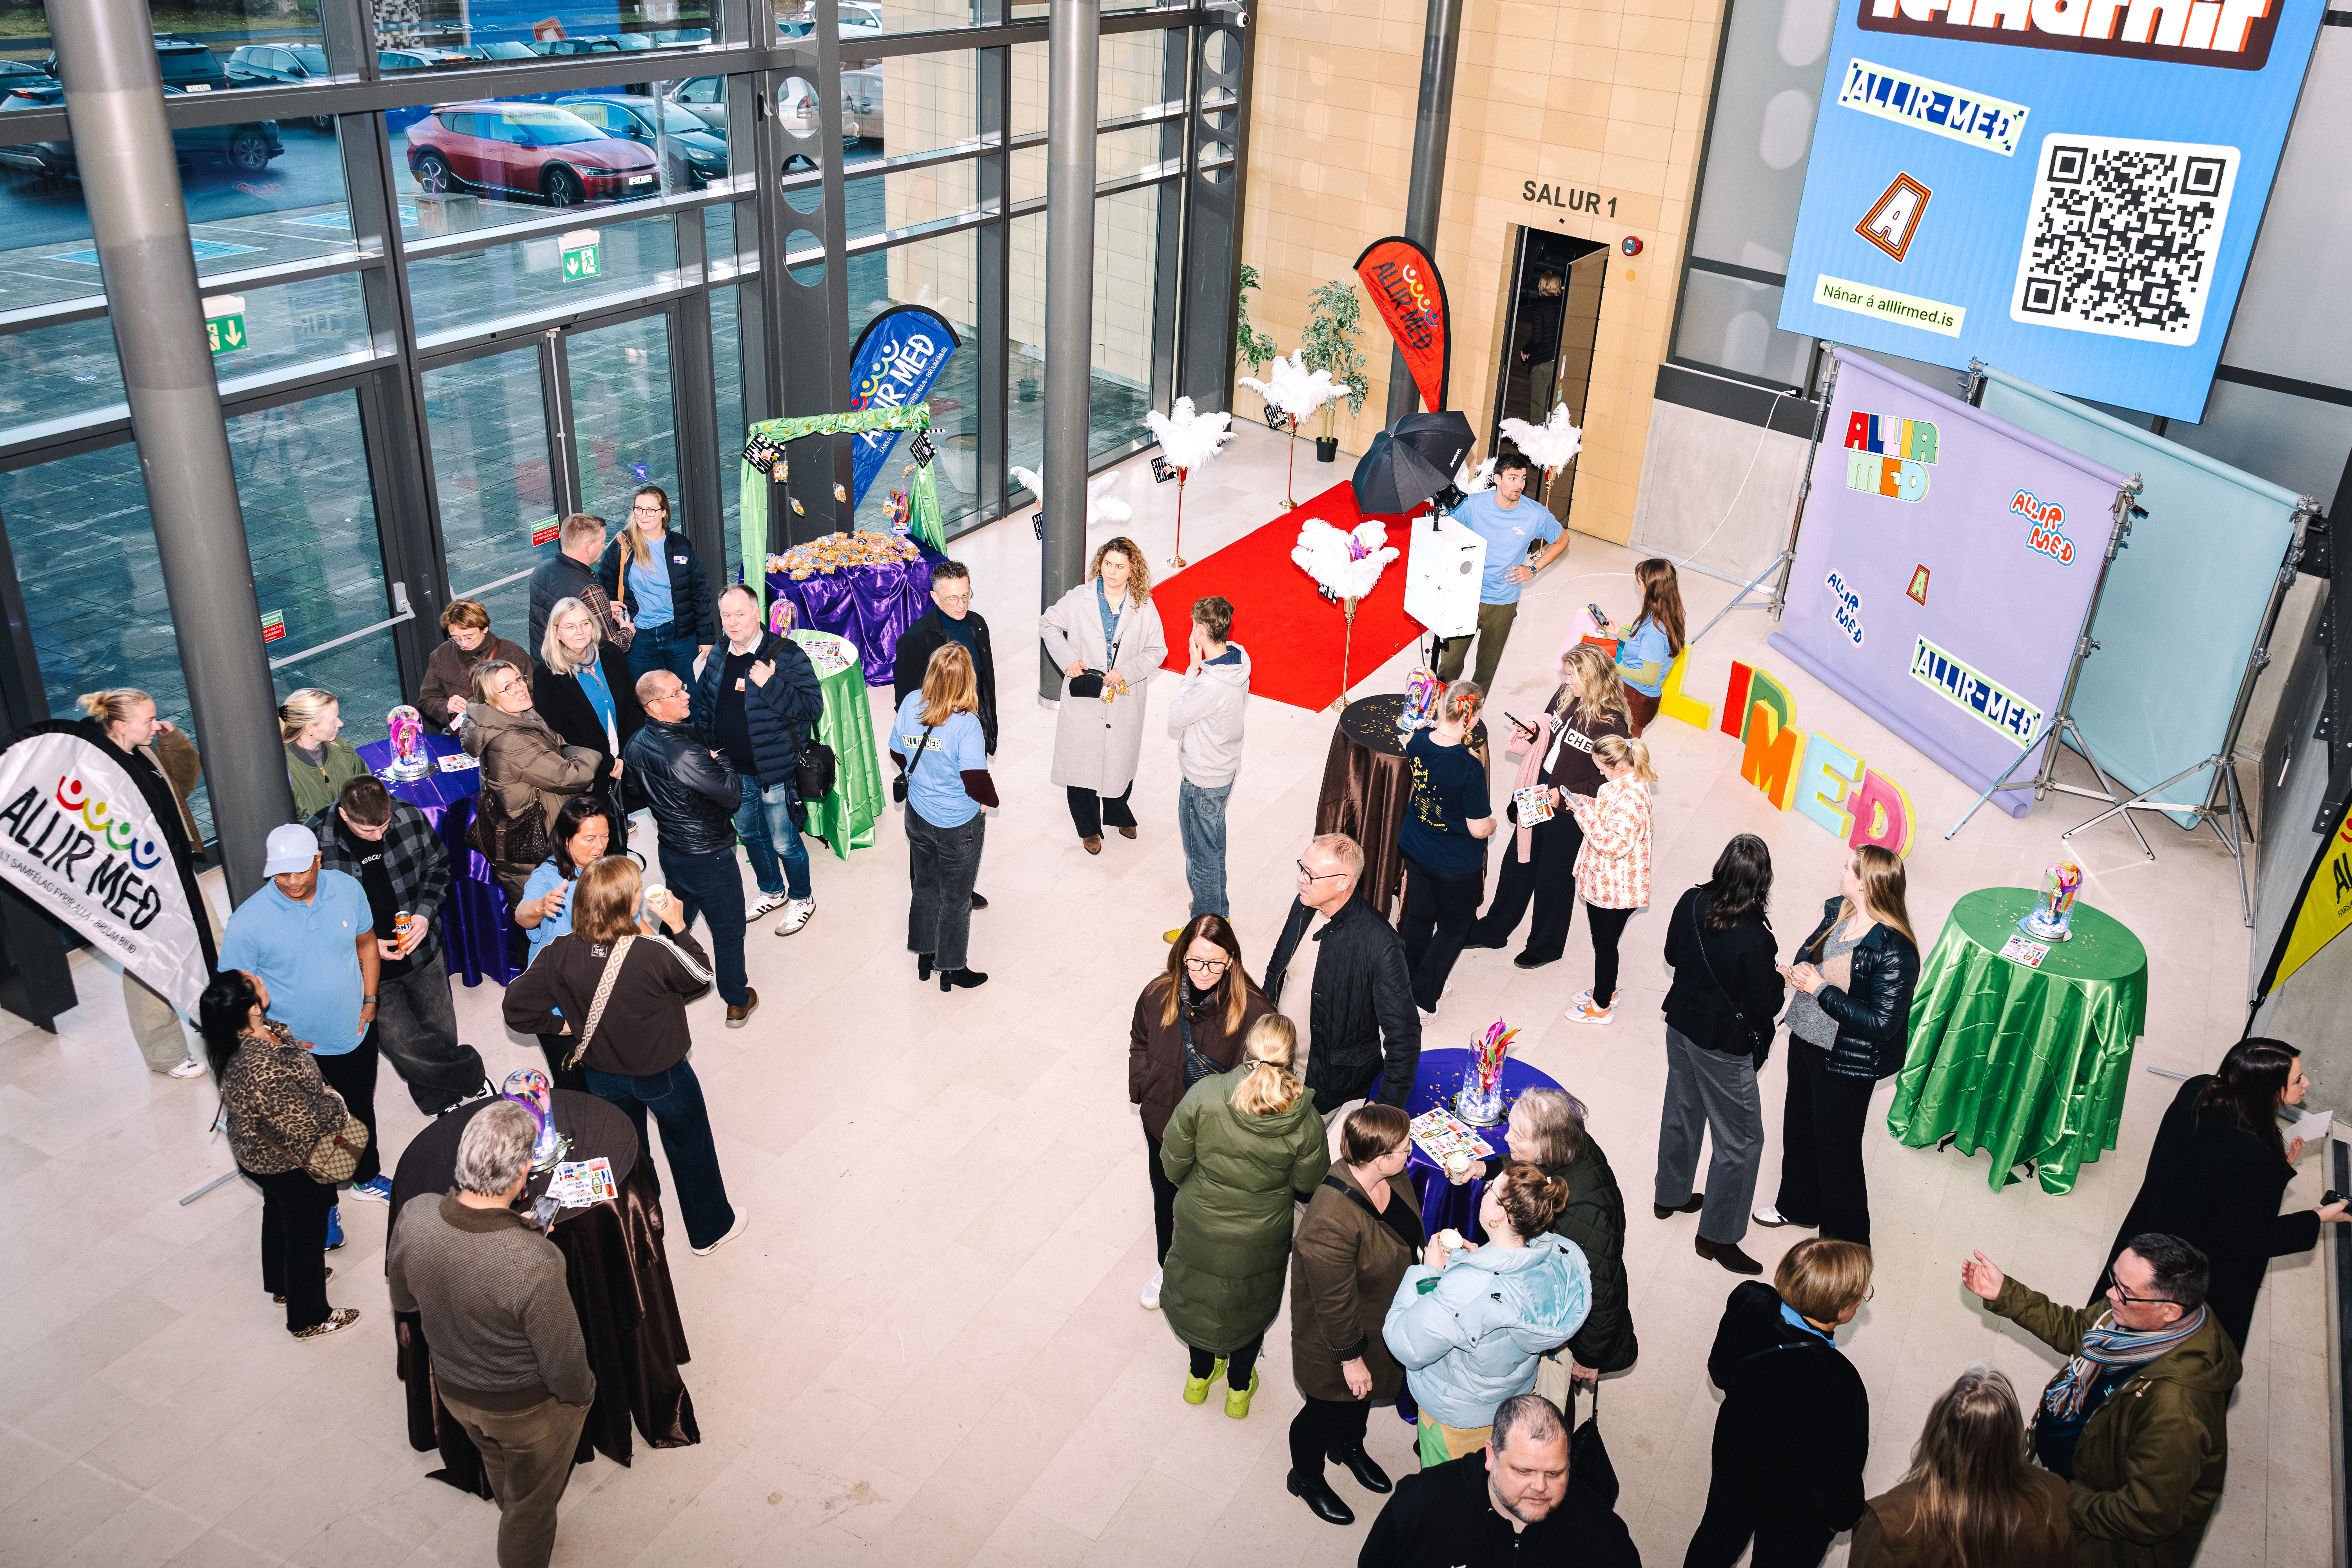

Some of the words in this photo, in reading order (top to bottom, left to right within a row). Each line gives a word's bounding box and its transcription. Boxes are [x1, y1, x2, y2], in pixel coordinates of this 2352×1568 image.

[1523, 180, 1601, 214] SALUR
[1608, 197, 1617, 218] 1
[1867, 184, 1920, 250] A
[1372, 261, 1412, 311] ALLIR
[1824, 284, 1863, 304] Nánar
[1866, 295, 1874, 307] á
[1878, 300, 1953, 326] alllirmed.is
[918, 381, 927, 394] ALLA
[1844, 411, 1939, 464] ALLIR
[2013, 494, 2062, 530] ALLIR
[1828, 573, 1858, 613] ALLIR
[1909, 568, 1928, 601] A
[0, 786, 95, 882] ALLIR
[362, 854, 381, 864] era
[11, 858, 53, 892] SAMFÉLAG
[53, 887, 75, 907] FYRIR
[73, 904, 93, 920] ALLA
[94, 919, 118, 942] BRÚUM
